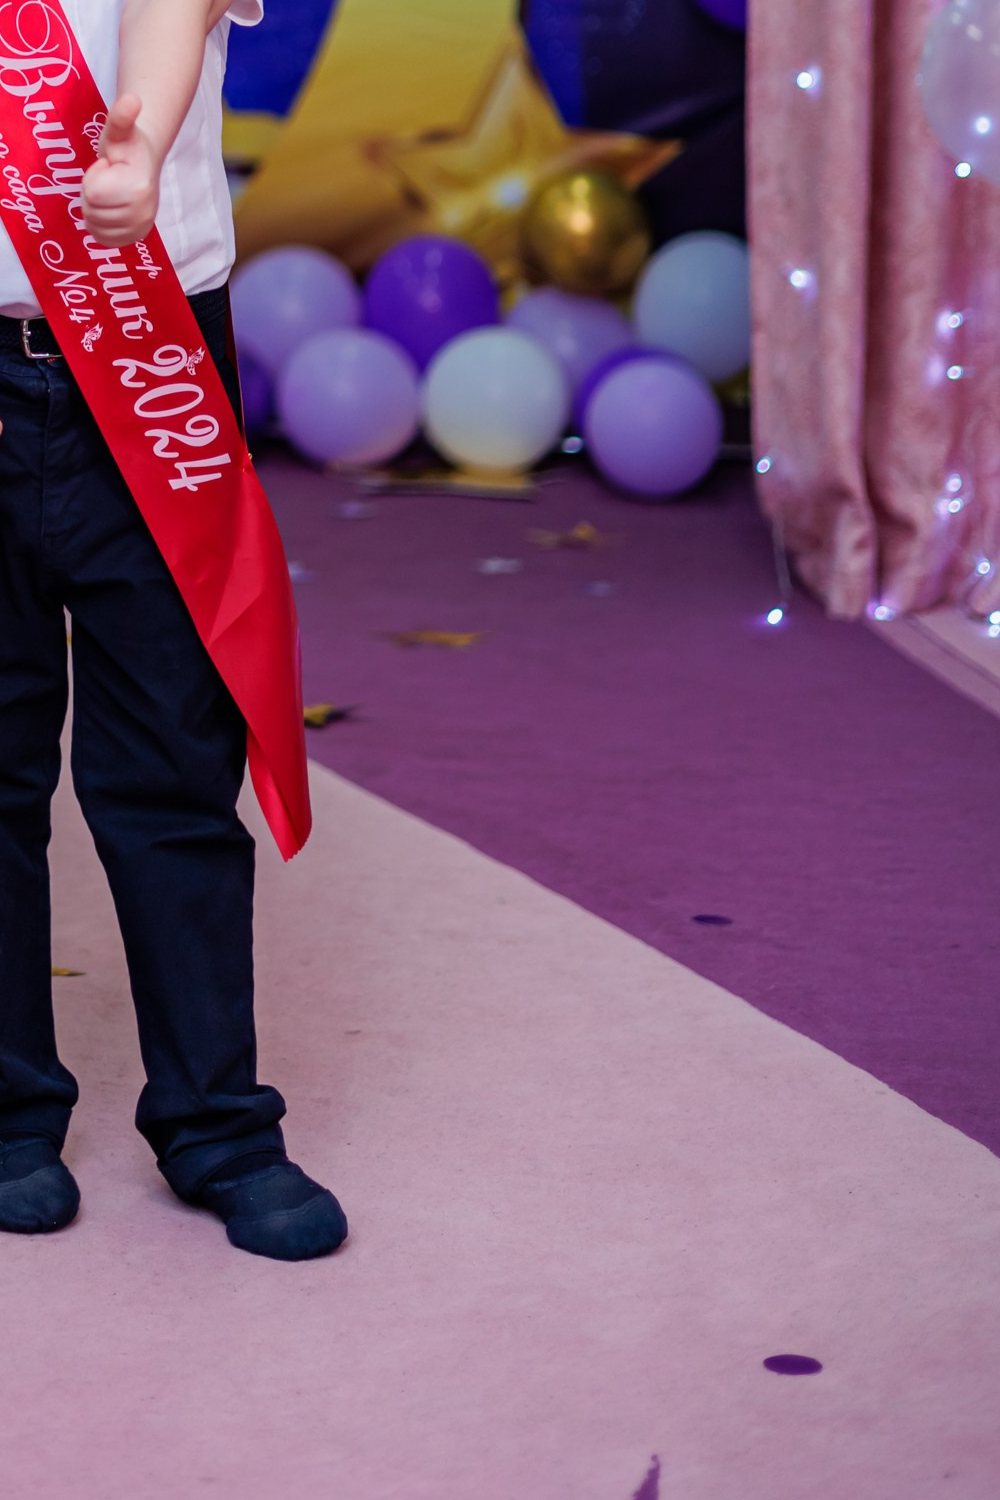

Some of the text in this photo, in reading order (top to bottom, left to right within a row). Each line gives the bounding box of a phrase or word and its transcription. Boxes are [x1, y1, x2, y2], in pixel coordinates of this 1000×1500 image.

[0, 165, 45, 235] сада
[38, 239, 99, 325] №4
[112, 343, 232, 493] 2024
